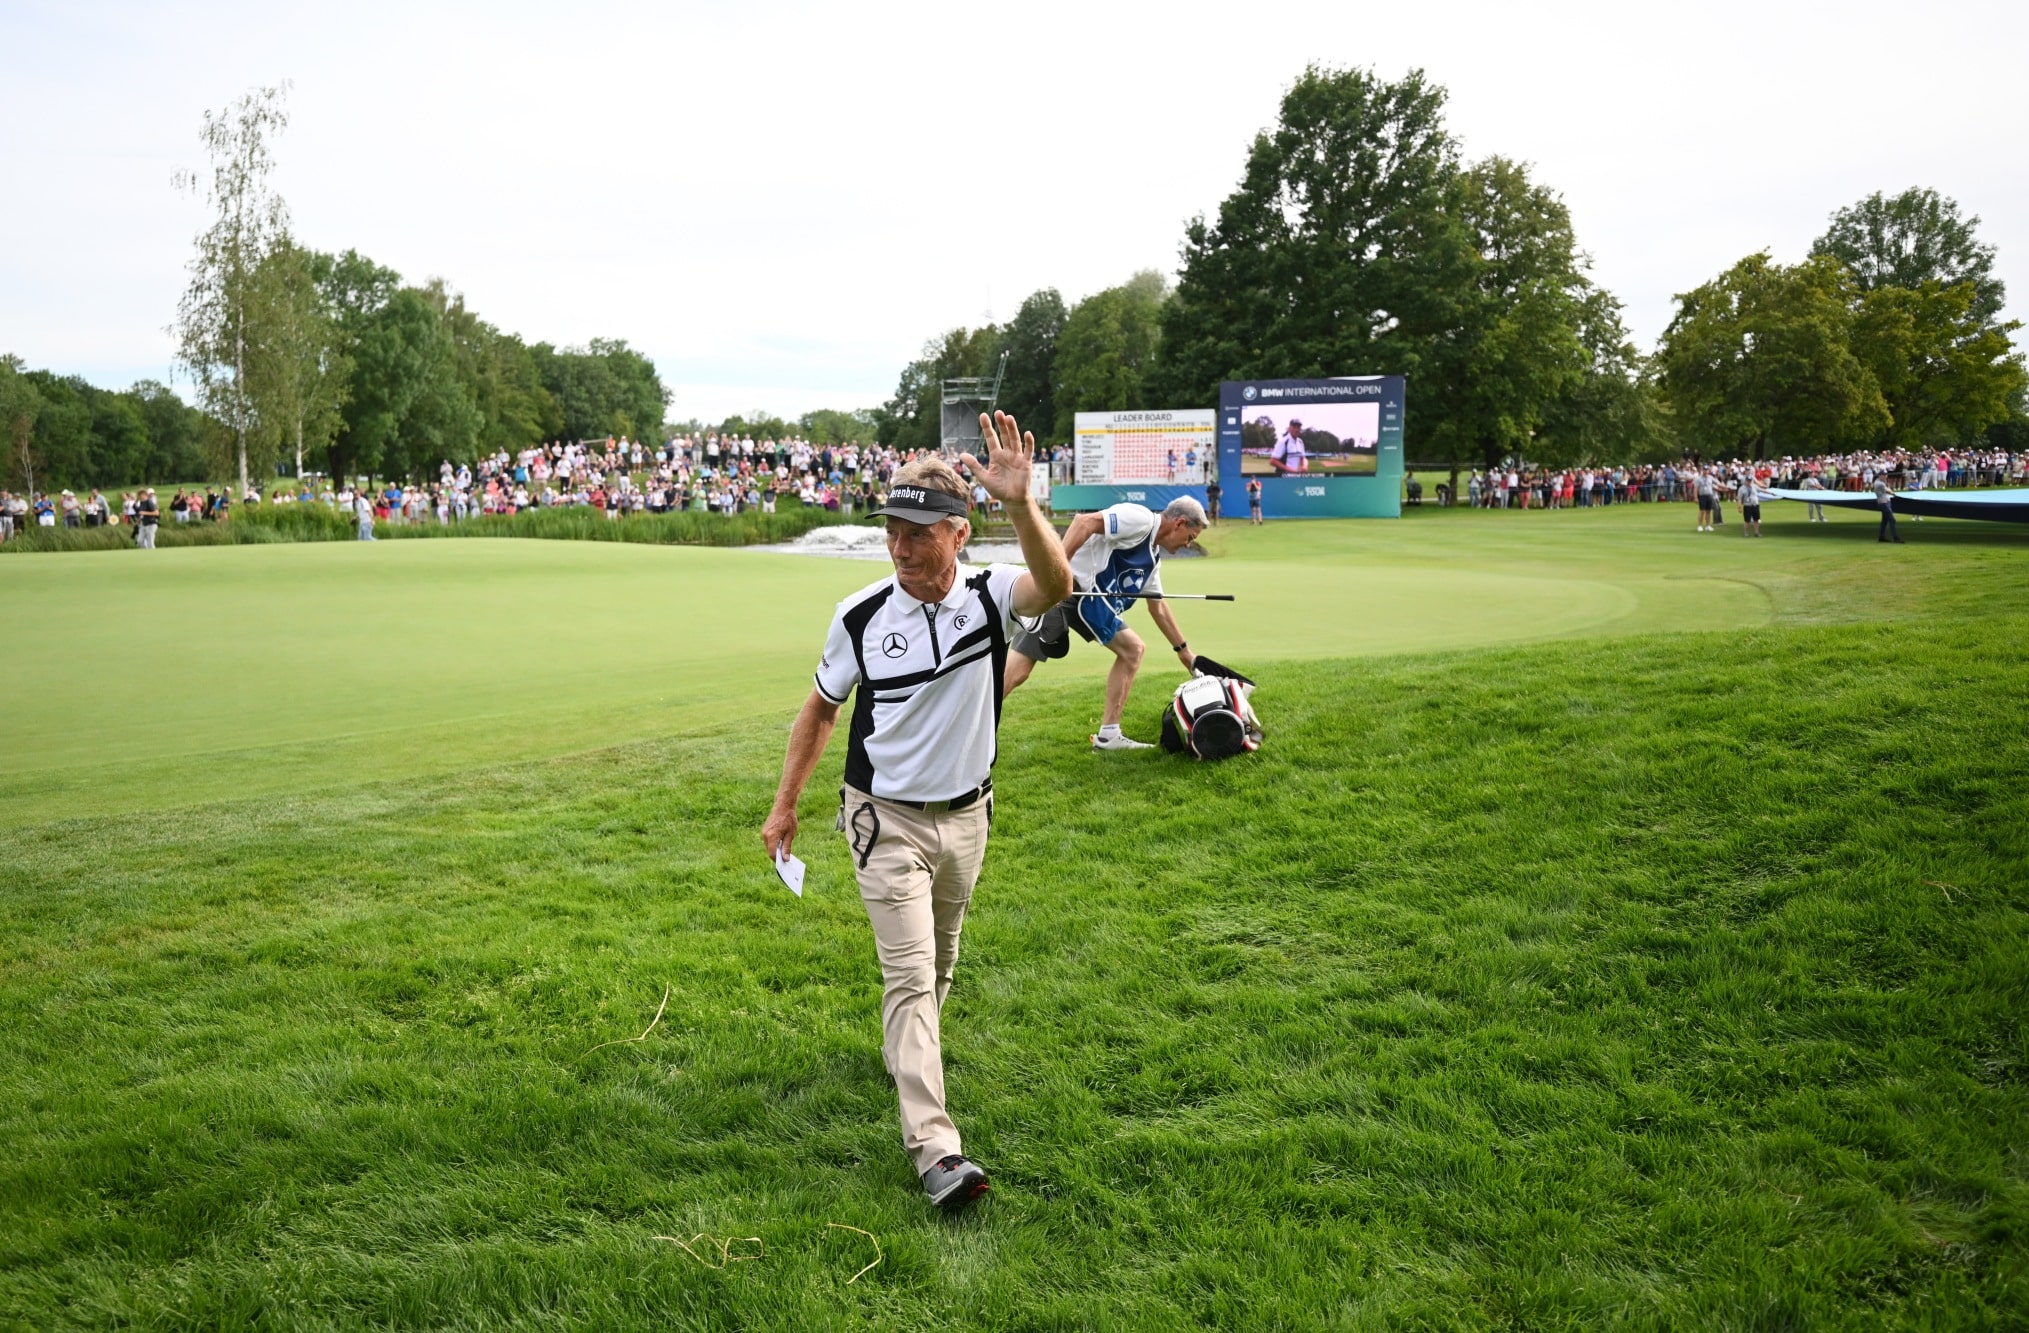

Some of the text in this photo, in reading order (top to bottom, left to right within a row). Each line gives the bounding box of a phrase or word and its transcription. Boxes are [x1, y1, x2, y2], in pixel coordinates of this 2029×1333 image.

[1261, 385, 1382, 398] BMW INTERNATIONAL OPEN
[1113, 413, 1172, 423] LEADER BOARD
